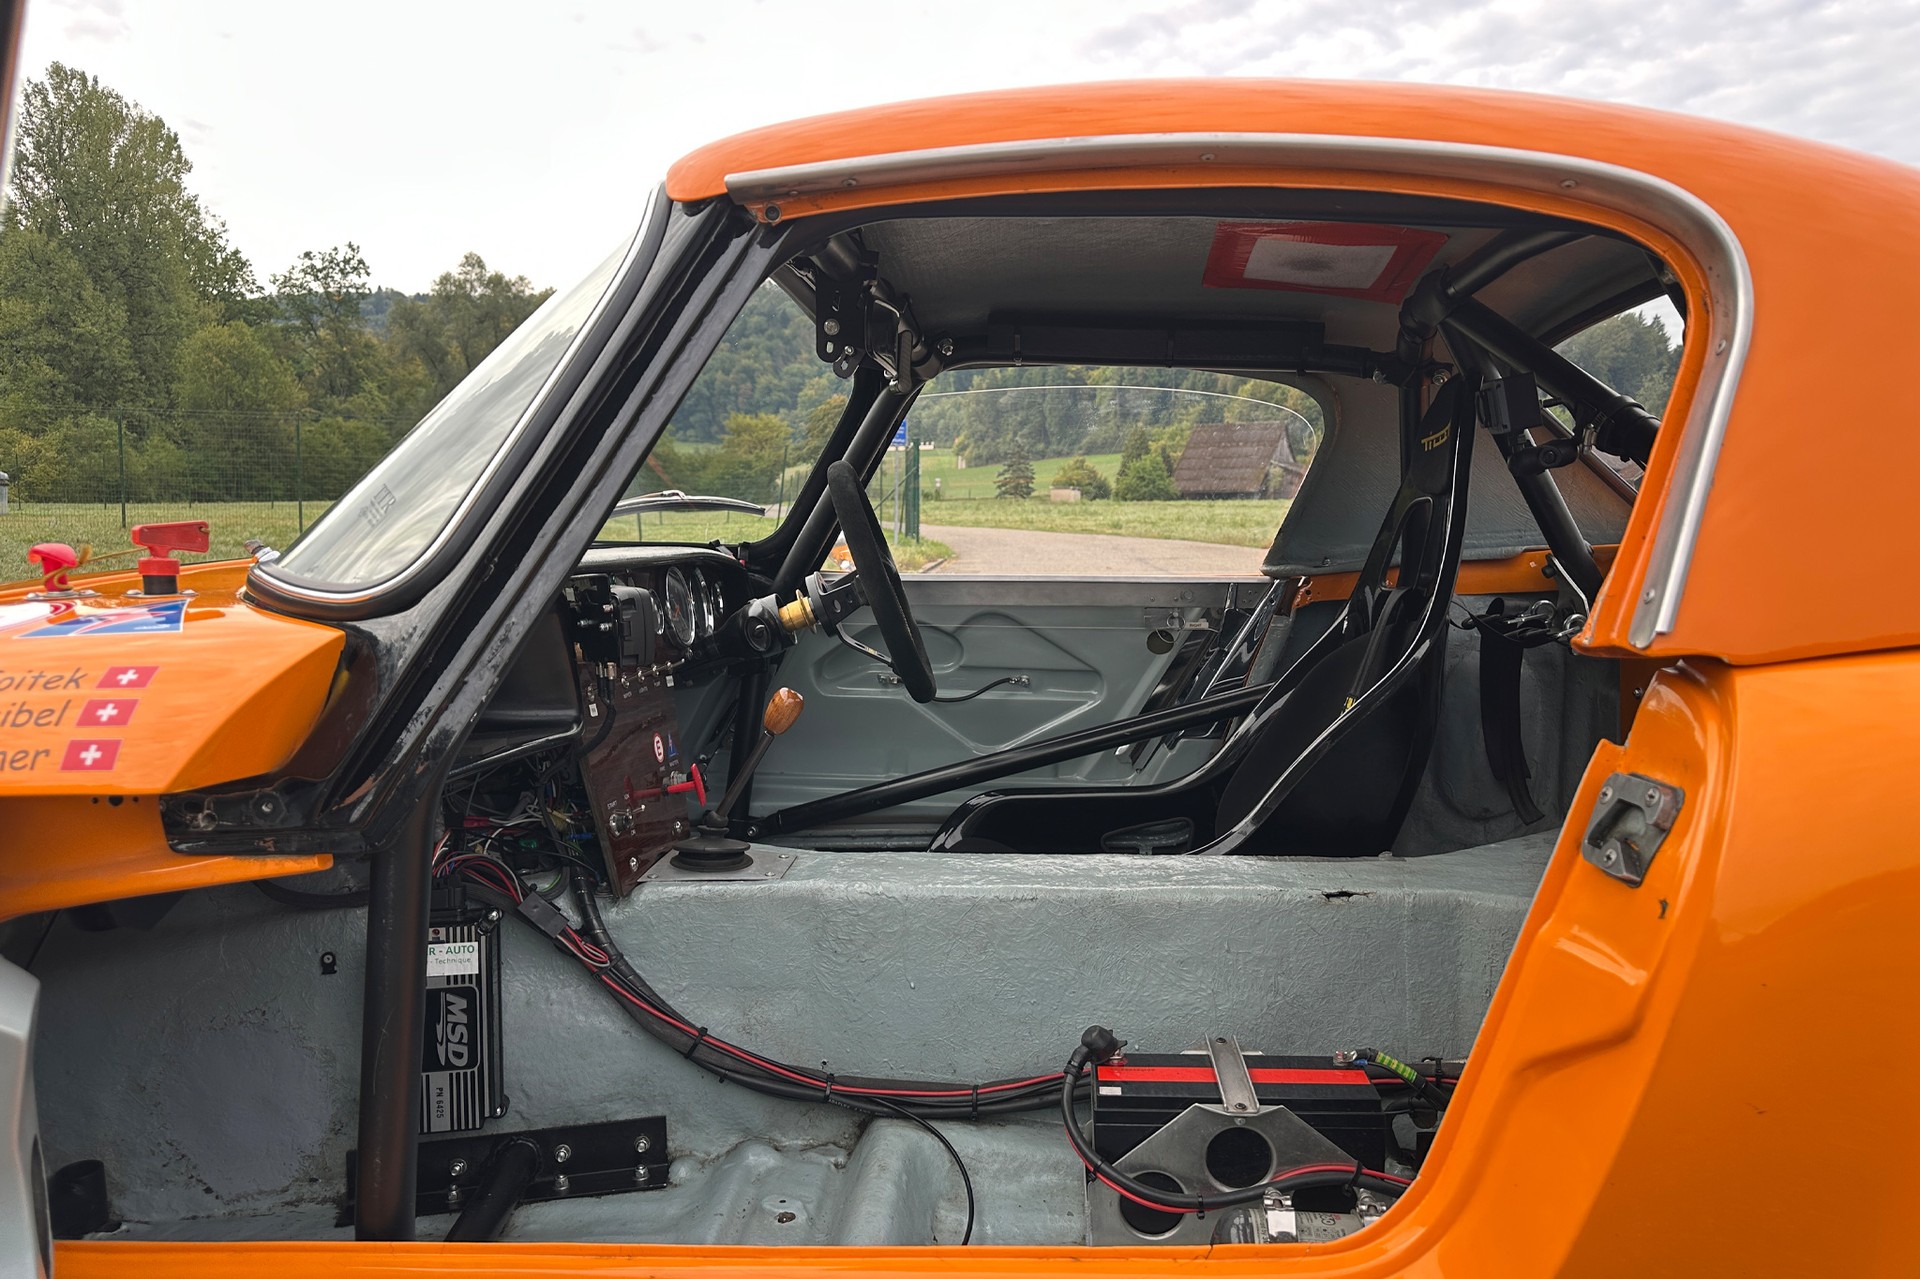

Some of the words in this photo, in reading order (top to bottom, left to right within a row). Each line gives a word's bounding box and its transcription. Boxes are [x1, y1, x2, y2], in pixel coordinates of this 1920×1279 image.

[0, 667, 88, 692] oitek
[0, 699, 72, 728] ibel
[445, 944, 475, 955] AUTO
[434, 957, 472, 965] Technique
[446, 993, 469, 1068] MSD
[436, 1087, 444, 1098] PN
[436, 1100, 444, 1119] 6425
